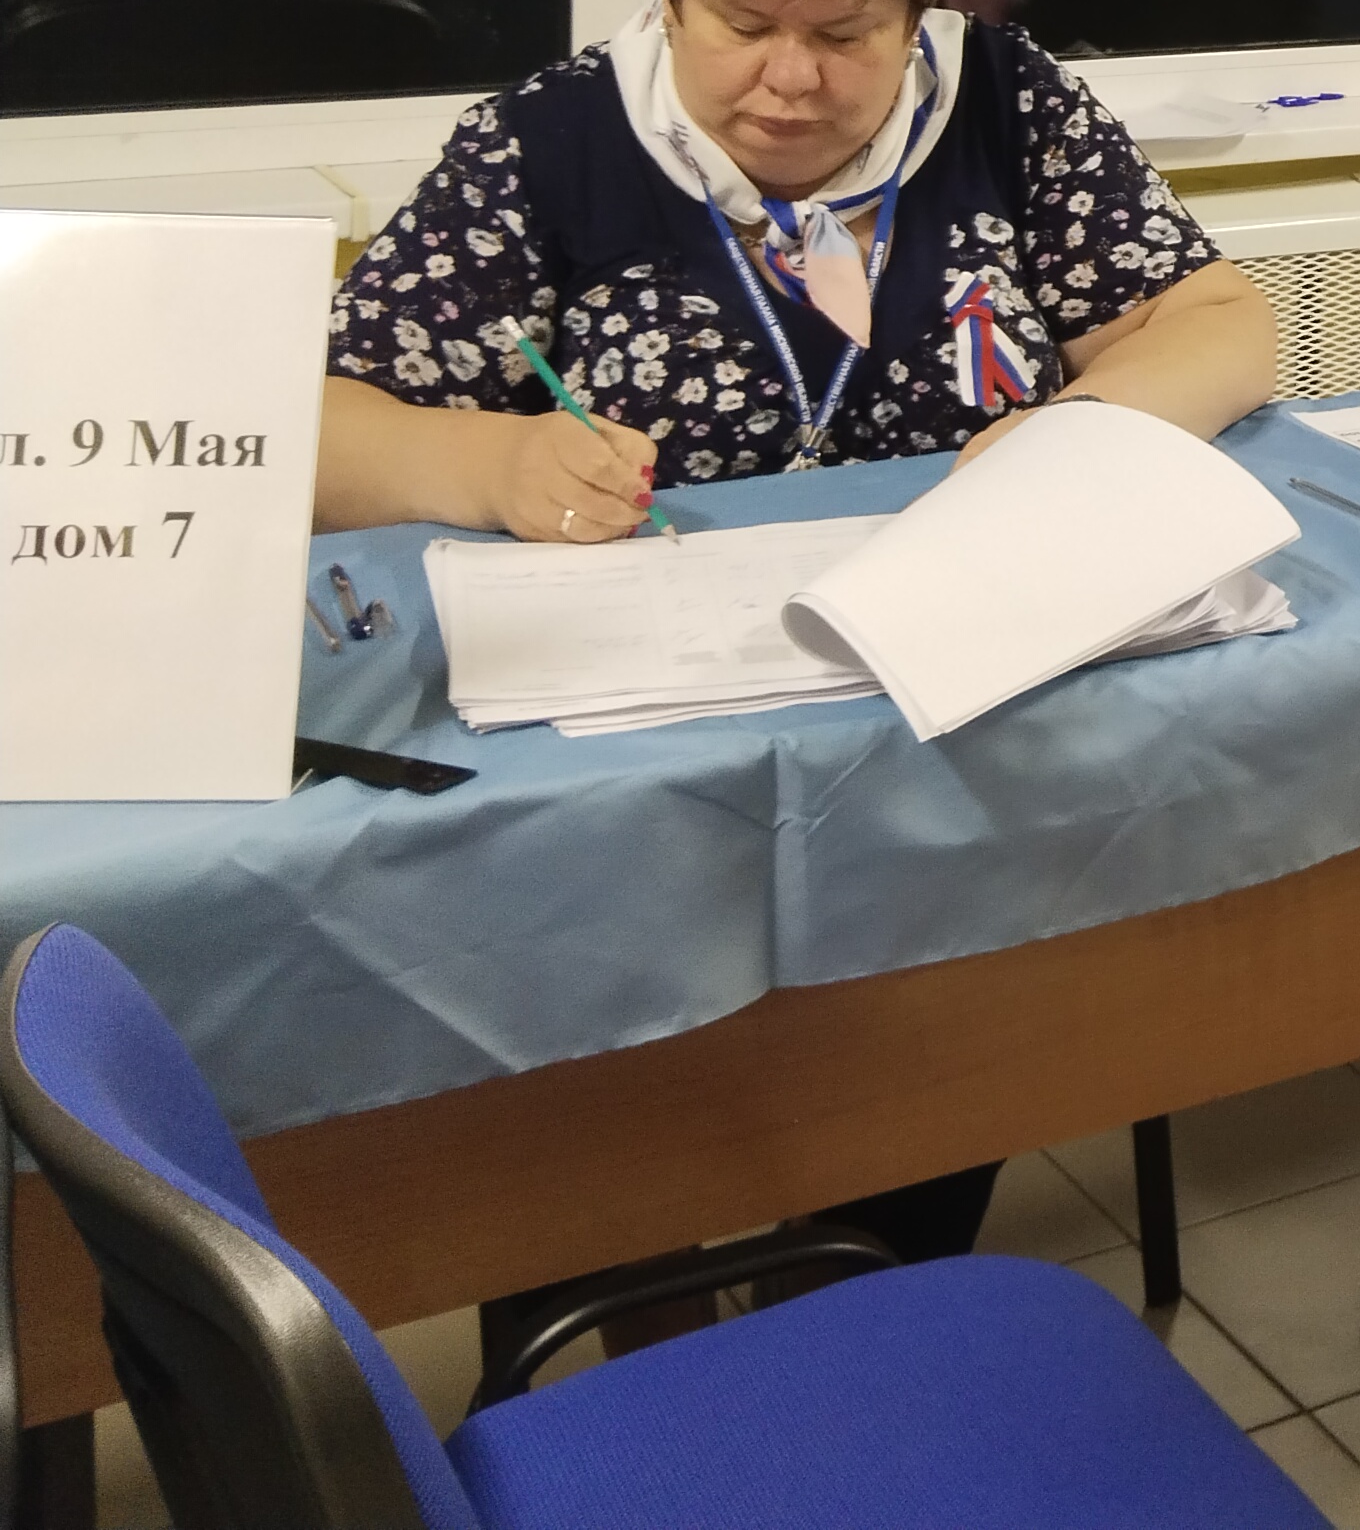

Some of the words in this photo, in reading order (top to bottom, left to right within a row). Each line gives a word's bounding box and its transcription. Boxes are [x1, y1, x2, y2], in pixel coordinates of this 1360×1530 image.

[69, 419, 104, 467] 9
[124, 419, 268, 468] Мая
[11, 523, 136, 565] дом
[162, 511, 196, 559] 7
